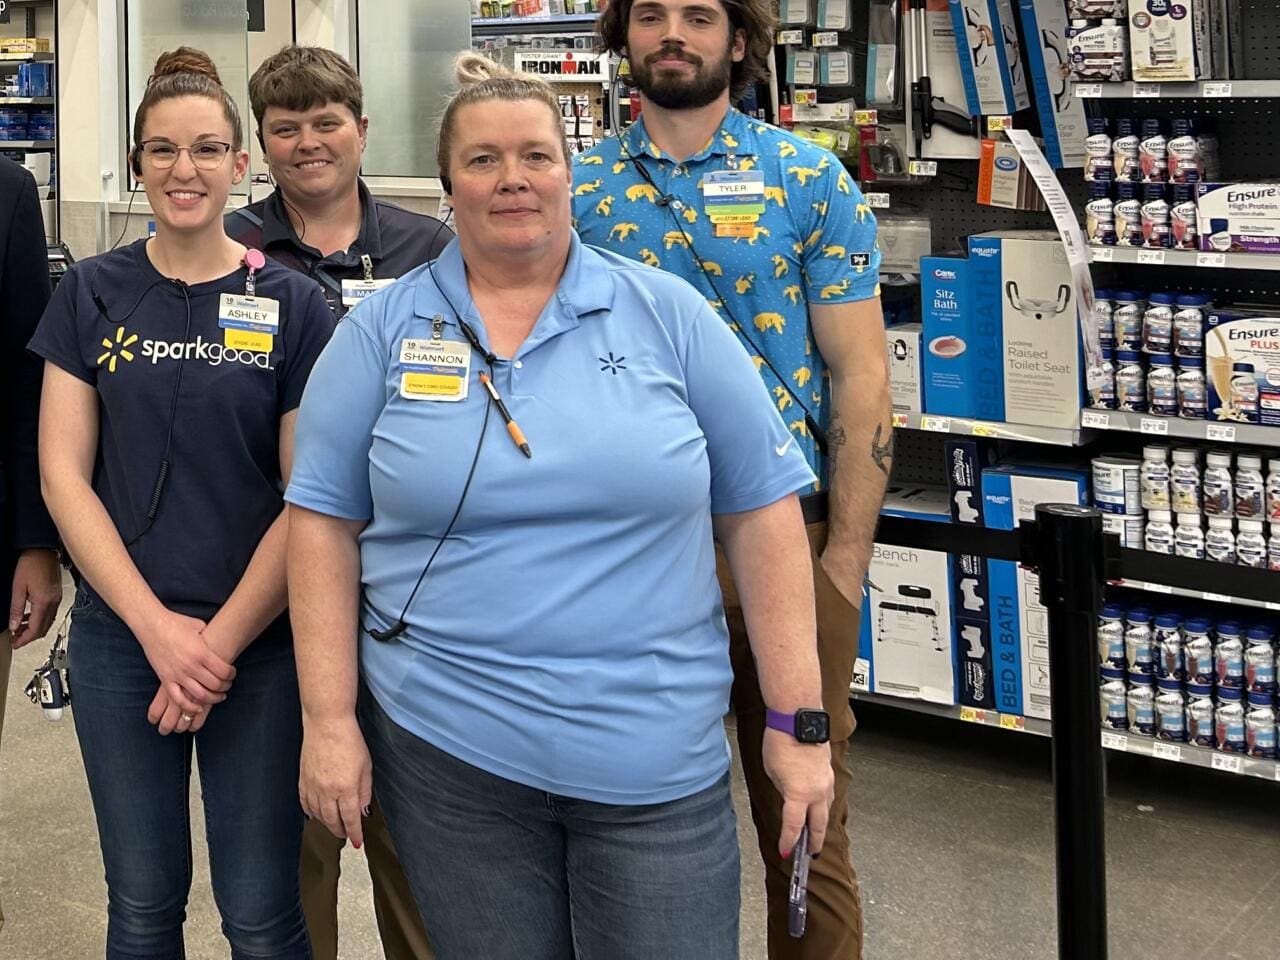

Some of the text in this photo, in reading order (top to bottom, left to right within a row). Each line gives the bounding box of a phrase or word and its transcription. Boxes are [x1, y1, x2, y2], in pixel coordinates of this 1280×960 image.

[1078, 31, 1105, 42] Ensure
[521, 58, 601, 75] IRONMAN
[719, 184, 747, 192] TYLER
[1227, 187, 1276, 202] Ensure
[1228, 203, 1248, 211] High
[1240, 235, 1280, 244] Strength
[971, 246, 1000, 256] equate
[935, 289, 955, 299] Sitz
[933, 299, 958, 310] Bath
[976, 269, 995, 338] BATH
[227, 309, 268, 321] ASHLEY
[1228, 327, 1279, 341] Ensure
[1250, 340, 1280, 350] PLUS
[404, 352, 464, 364] SHANNON
[1008, 346, 1048, 360] Raised
[1008, 359, 1072, 374] Toilet Seat
[872, 545, 918, 563] Bench
[998, 595, 1017, 708] BED & BATH
